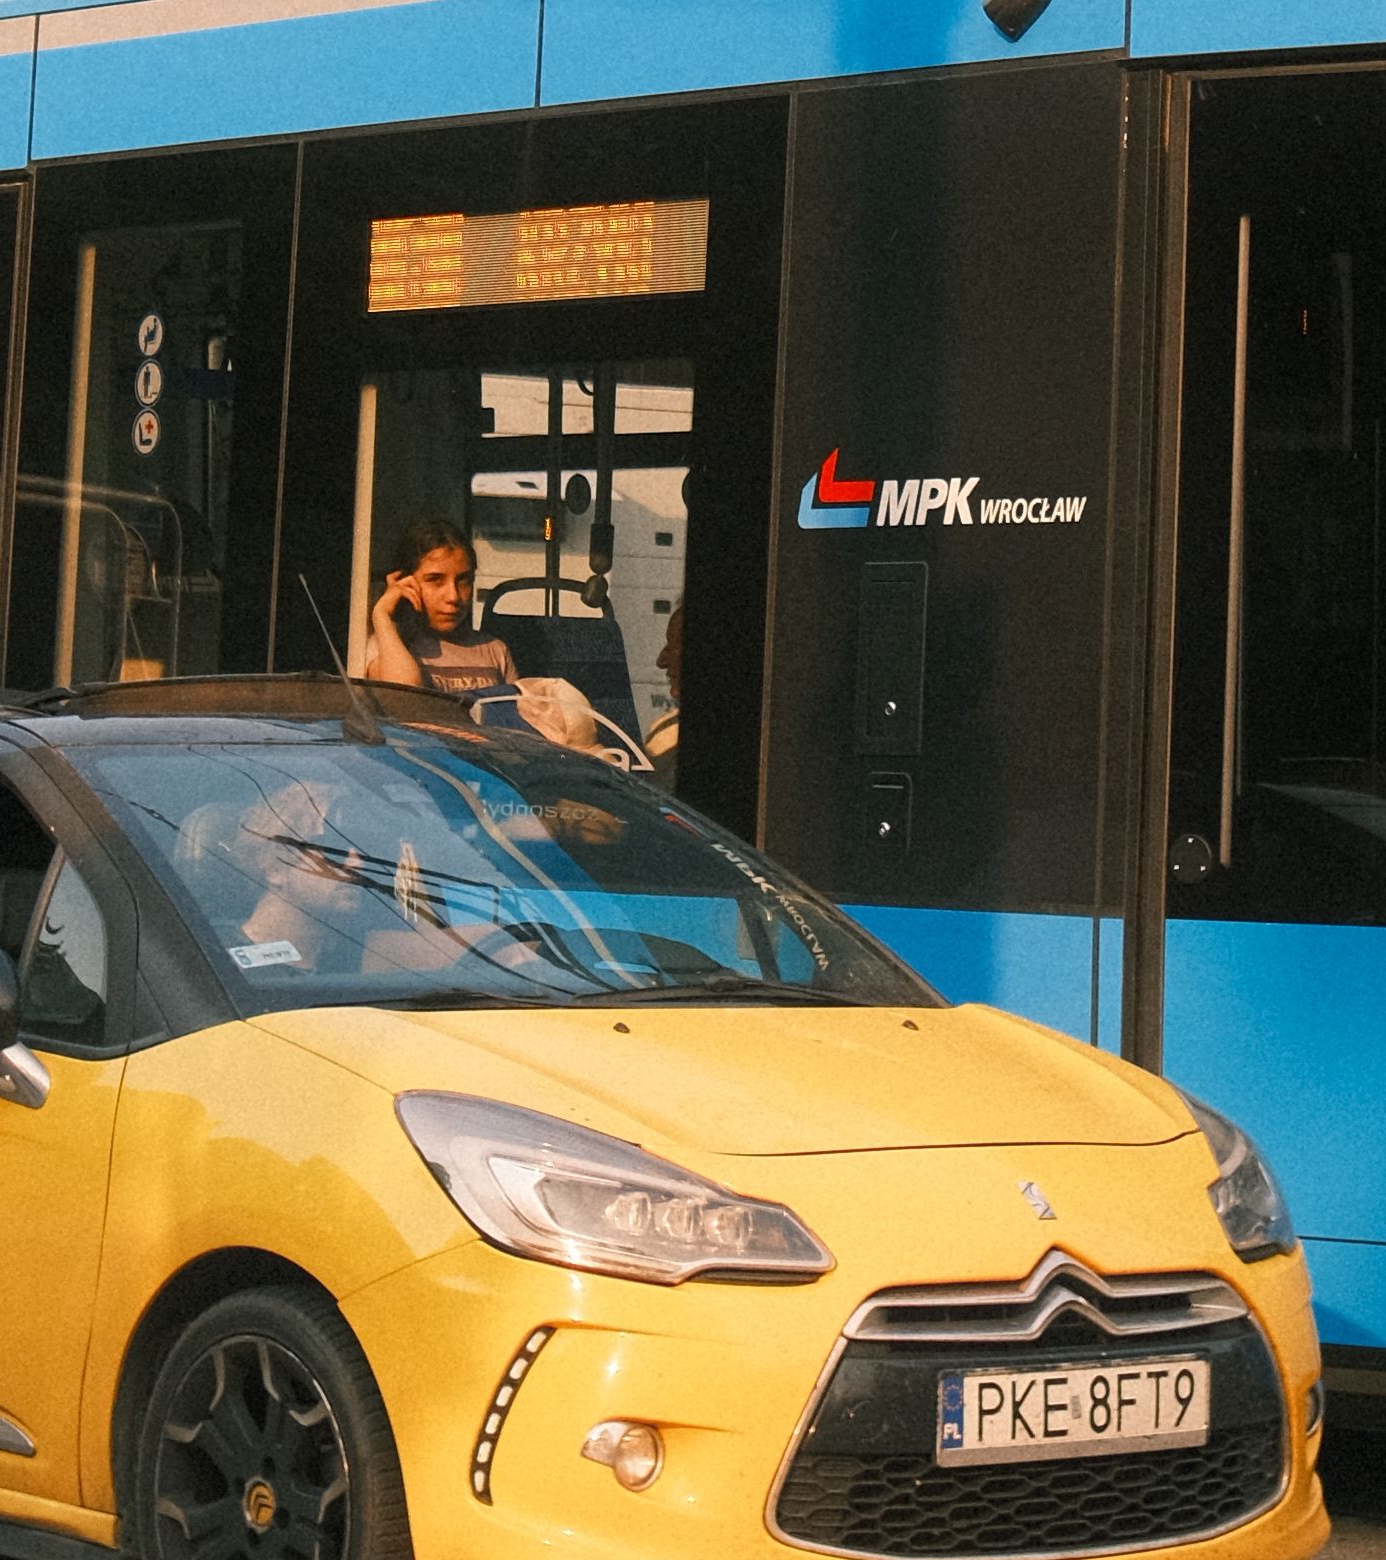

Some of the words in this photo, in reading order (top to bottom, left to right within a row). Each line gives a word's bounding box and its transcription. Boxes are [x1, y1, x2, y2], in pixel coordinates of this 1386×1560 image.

[876, 477, 980, 527] MPK
[980, 497, 1087, 525] WROCŁAW
[977, 1377, 1069, 1442] PKE
[1089, 1368, 1195, 1433] 8FT9
[943, 1422, 962, 1441] PL
